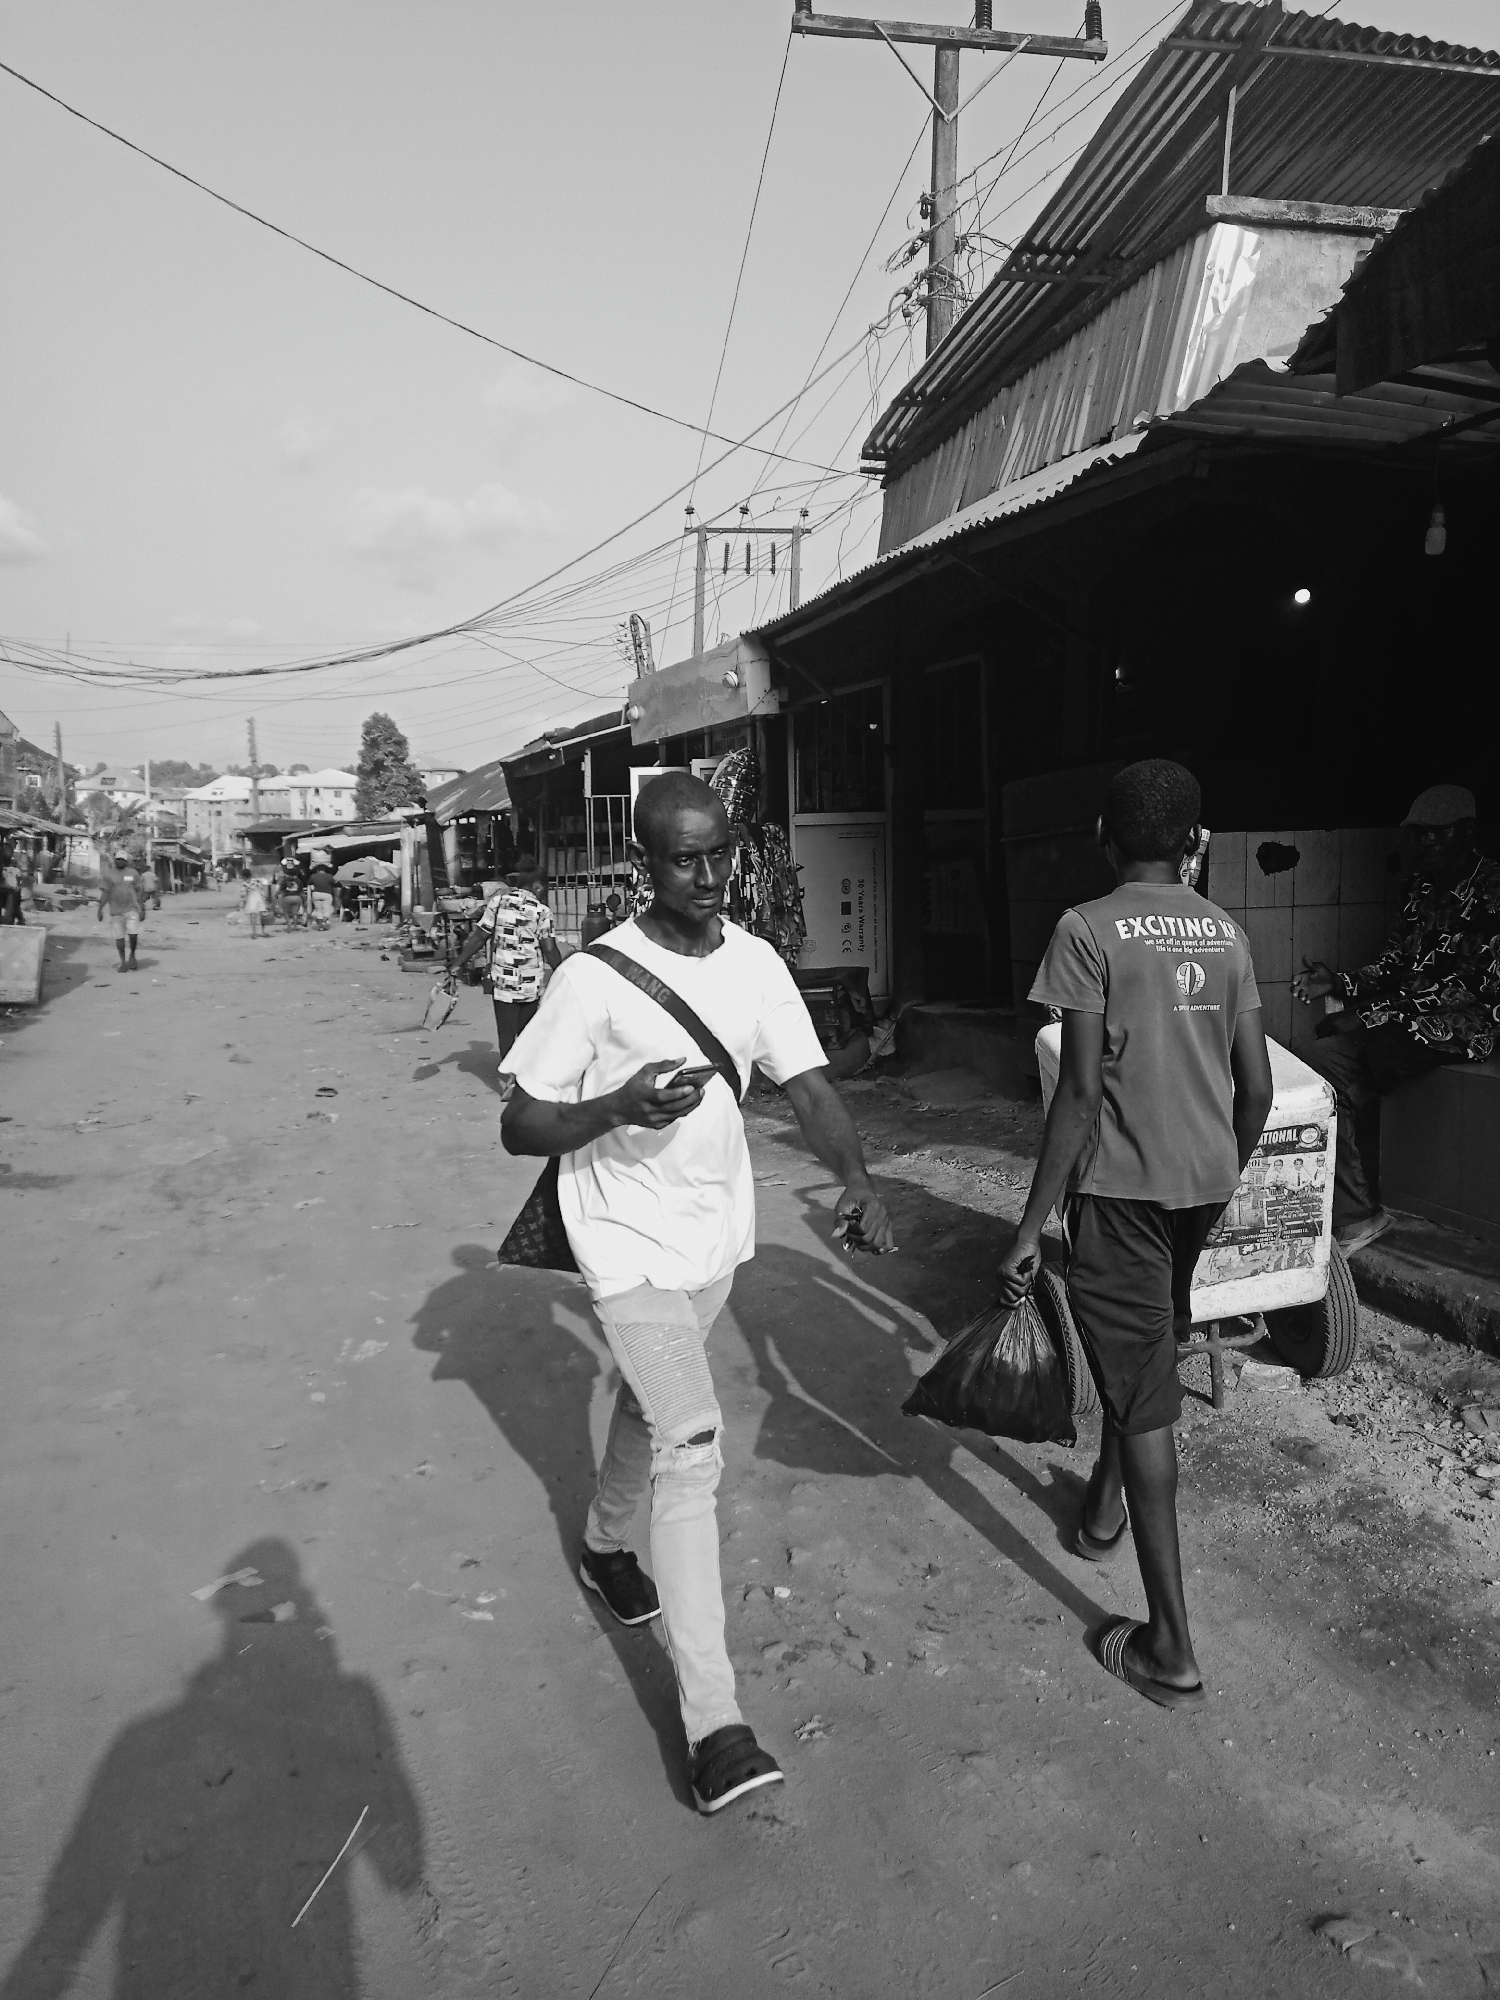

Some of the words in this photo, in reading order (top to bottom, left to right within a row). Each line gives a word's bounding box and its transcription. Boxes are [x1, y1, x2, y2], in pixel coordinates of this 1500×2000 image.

[858, 878, 865, 888] 30
[857, 890, 865, 913] Years
[857, 915, 865, 952] Warranty
[1115, 915, 1217, 940] EXCITING
[1183, 946, 1193, 954] big
